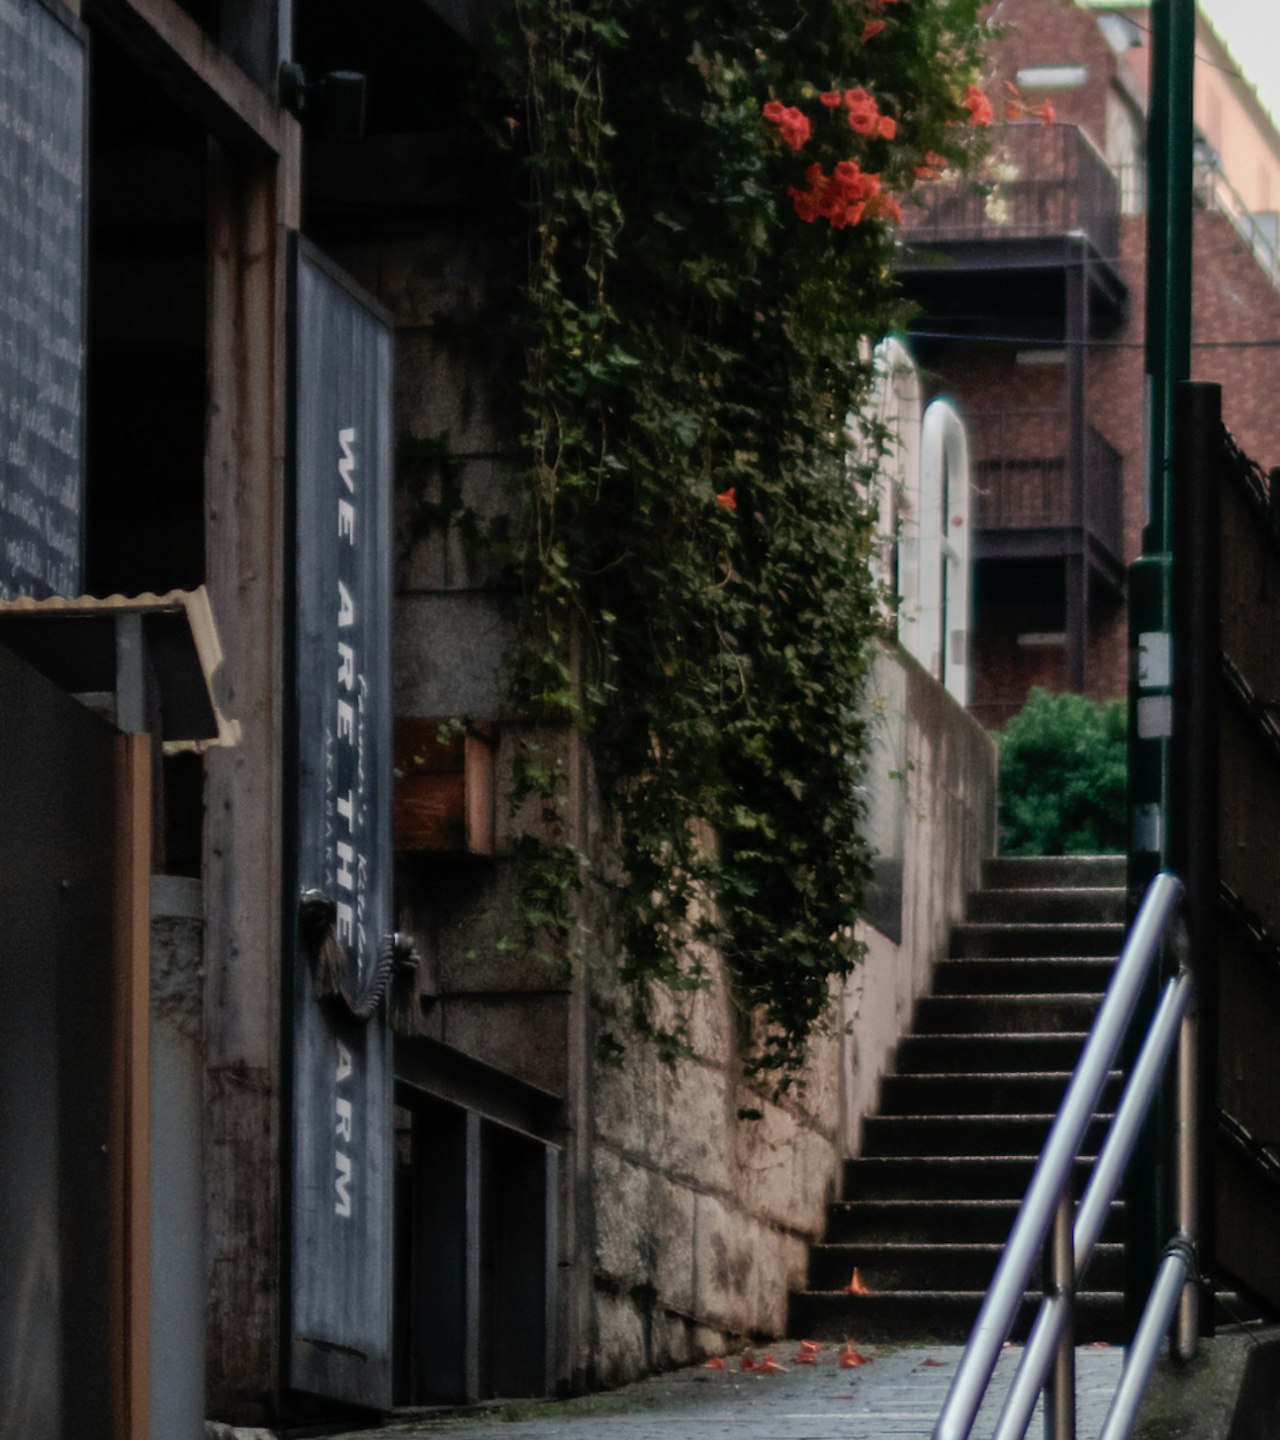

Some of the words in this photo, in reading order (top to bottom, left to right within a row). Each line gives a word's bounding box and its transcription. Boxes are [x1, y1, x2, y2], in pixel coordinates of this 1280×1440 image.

[337, 427, 355, 546] WE
[337, 579, 354, 746] ARE
[357, 673, 368, 826] Farmer's
[336, 788, 353, 947] THE
[335, 1037, 352, 1219] ARM
